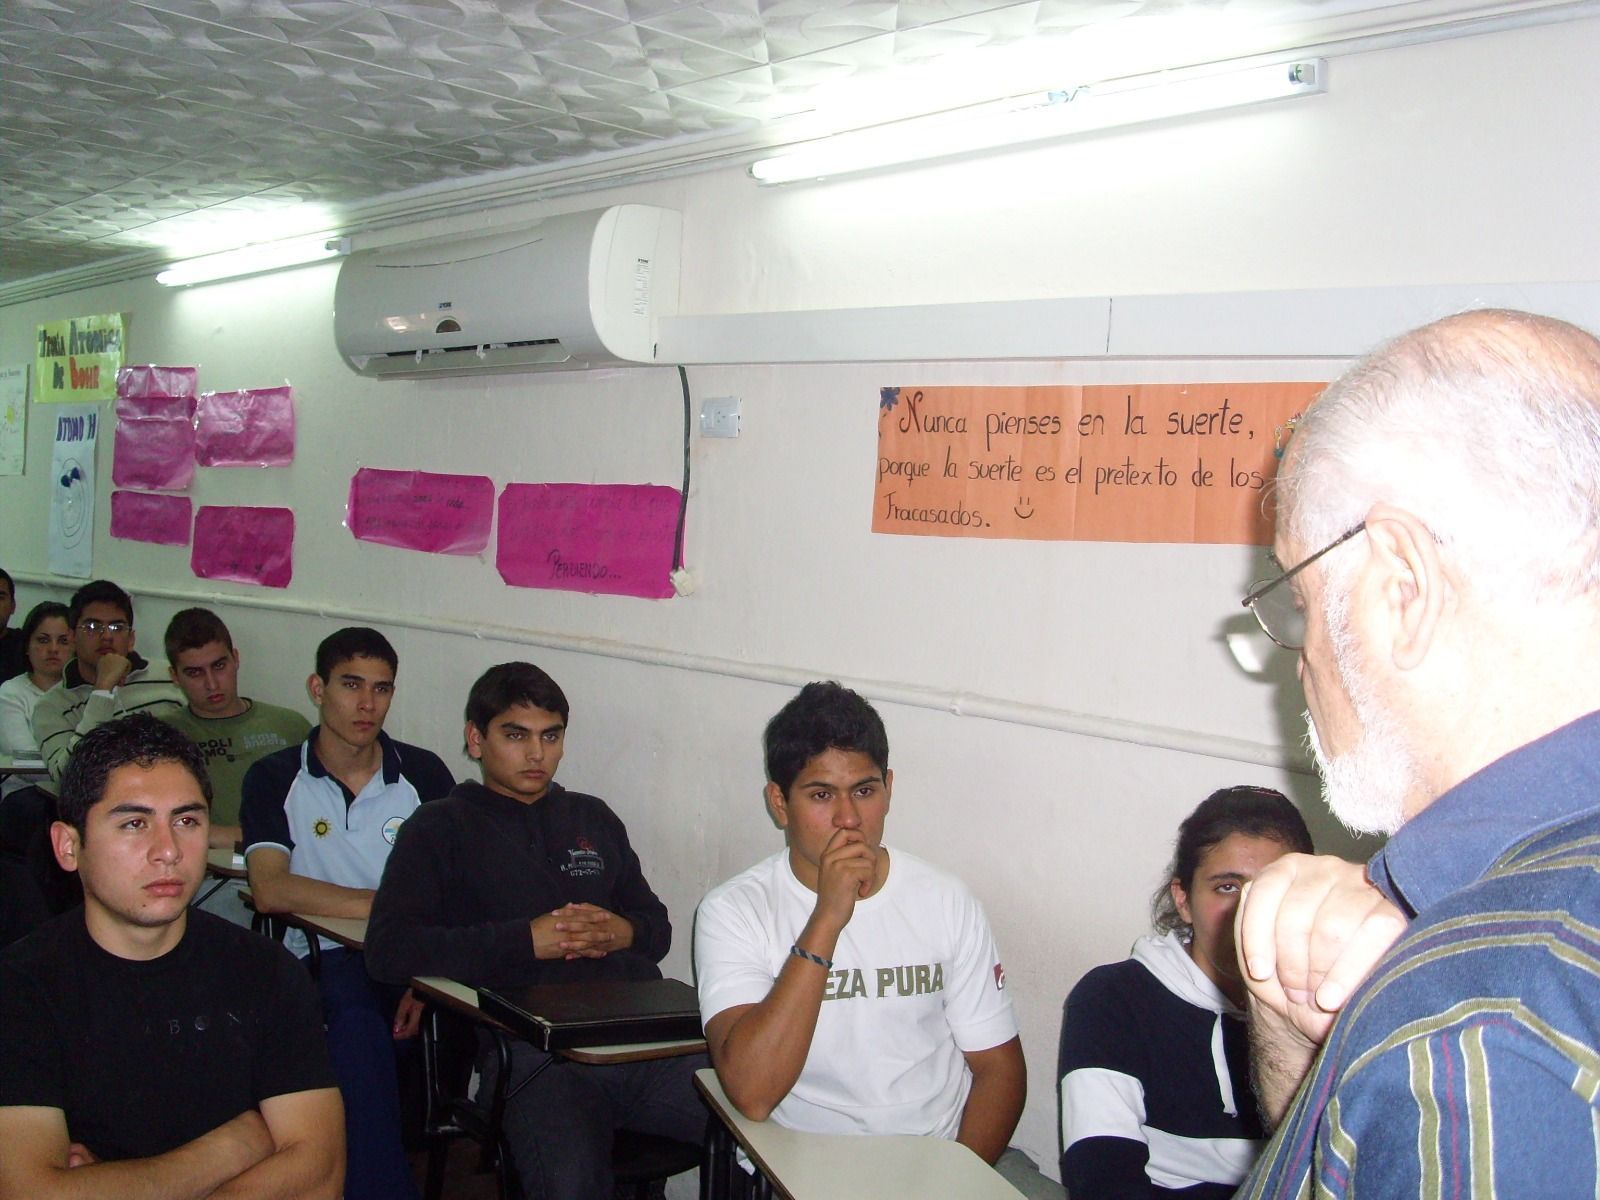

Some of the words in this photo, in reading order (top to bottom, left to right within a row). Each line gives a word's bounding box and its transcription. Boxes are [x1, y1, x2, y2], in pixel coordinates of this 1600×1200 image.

[87, 413, 97, 441] H
[899, 390, 968, 434] Nunca
[986, 411, 1061, 452] pienses
[1078, 413, 1104, 436] en
[1124, 395, 1147, 435] la
[1167, 398, 1255, 440] suerte,
[878, 456, 931, 488] porque
[943, 445, 958, 479] la
[967, 454, 1023, 482] suerte
[1035, 463, 1056, 482] es
[1065, 455, 1083, 484] el
[1094, 455, 1178, 495] pretexto
[1191, 457, 1214, 487] de
[1231, 457, 1266, 490] los
[198, 737, 233, 750] POLI
[823, 968, 868, 1000] EZA
[876, 962, 944, 999] PURA
